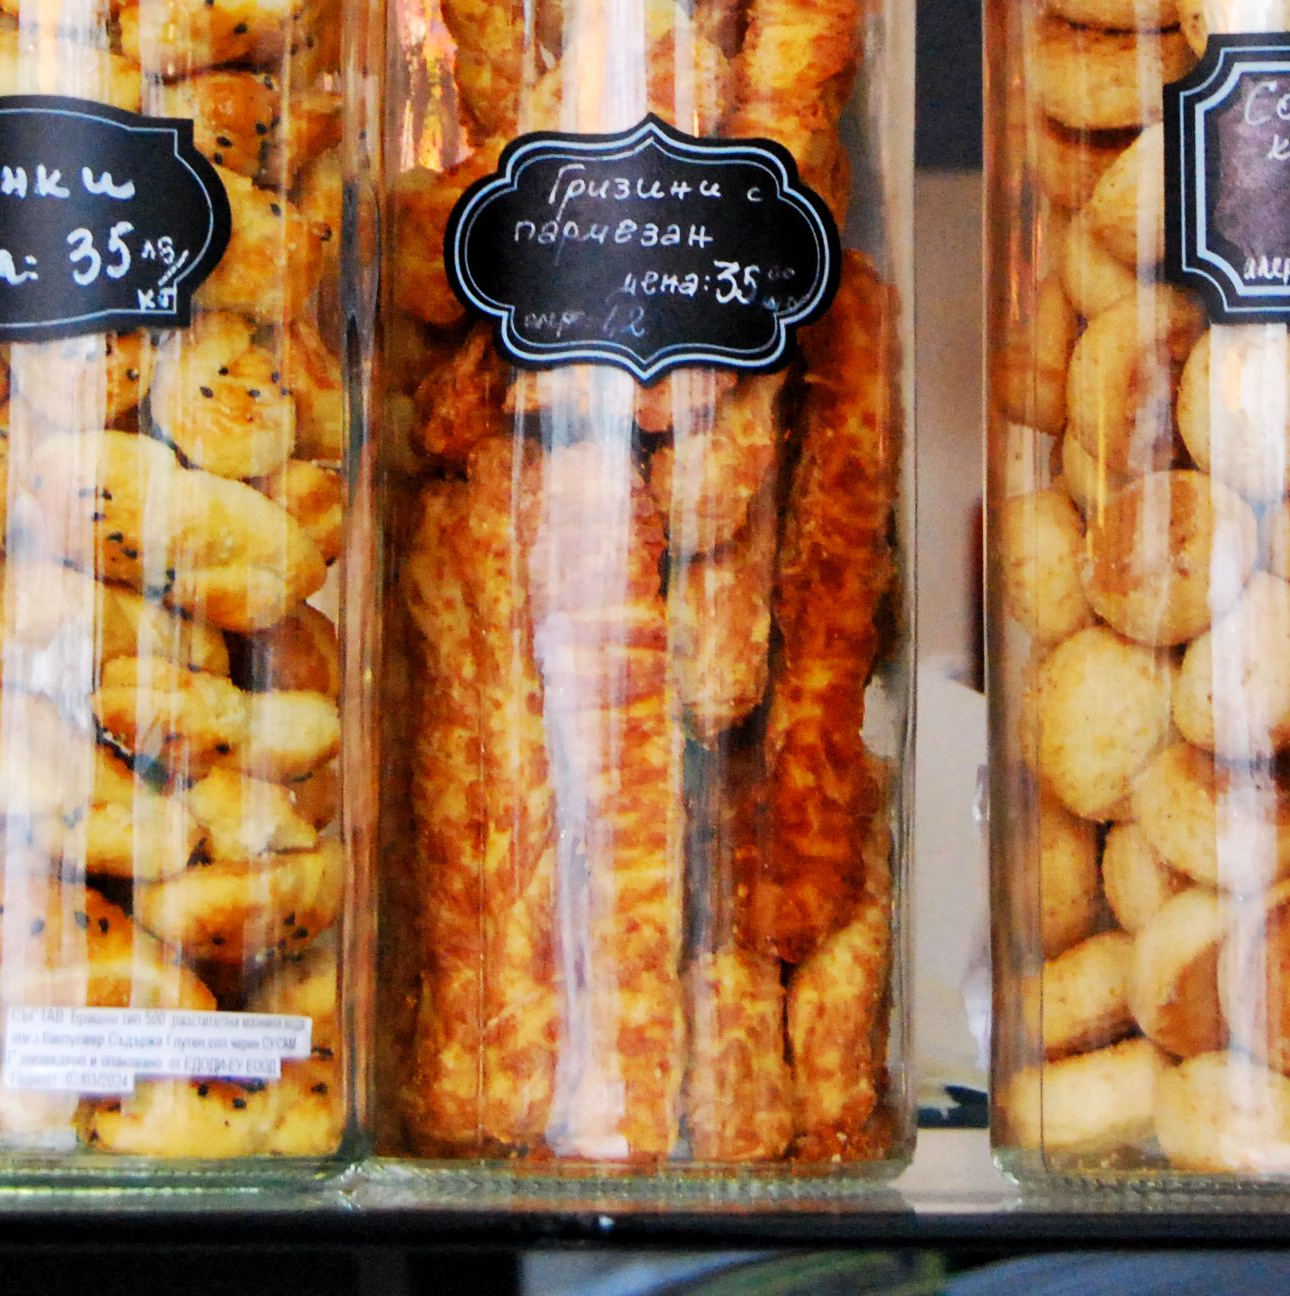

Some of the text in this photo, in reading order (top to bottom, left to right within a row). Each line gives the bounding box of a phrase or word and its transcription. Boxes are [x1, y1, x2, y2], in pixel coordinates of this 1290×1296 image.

[547, 163, 722, 221] Гризини
[66, 220, 135, 286] 35
[514, 218, 714, 266] пармезан
